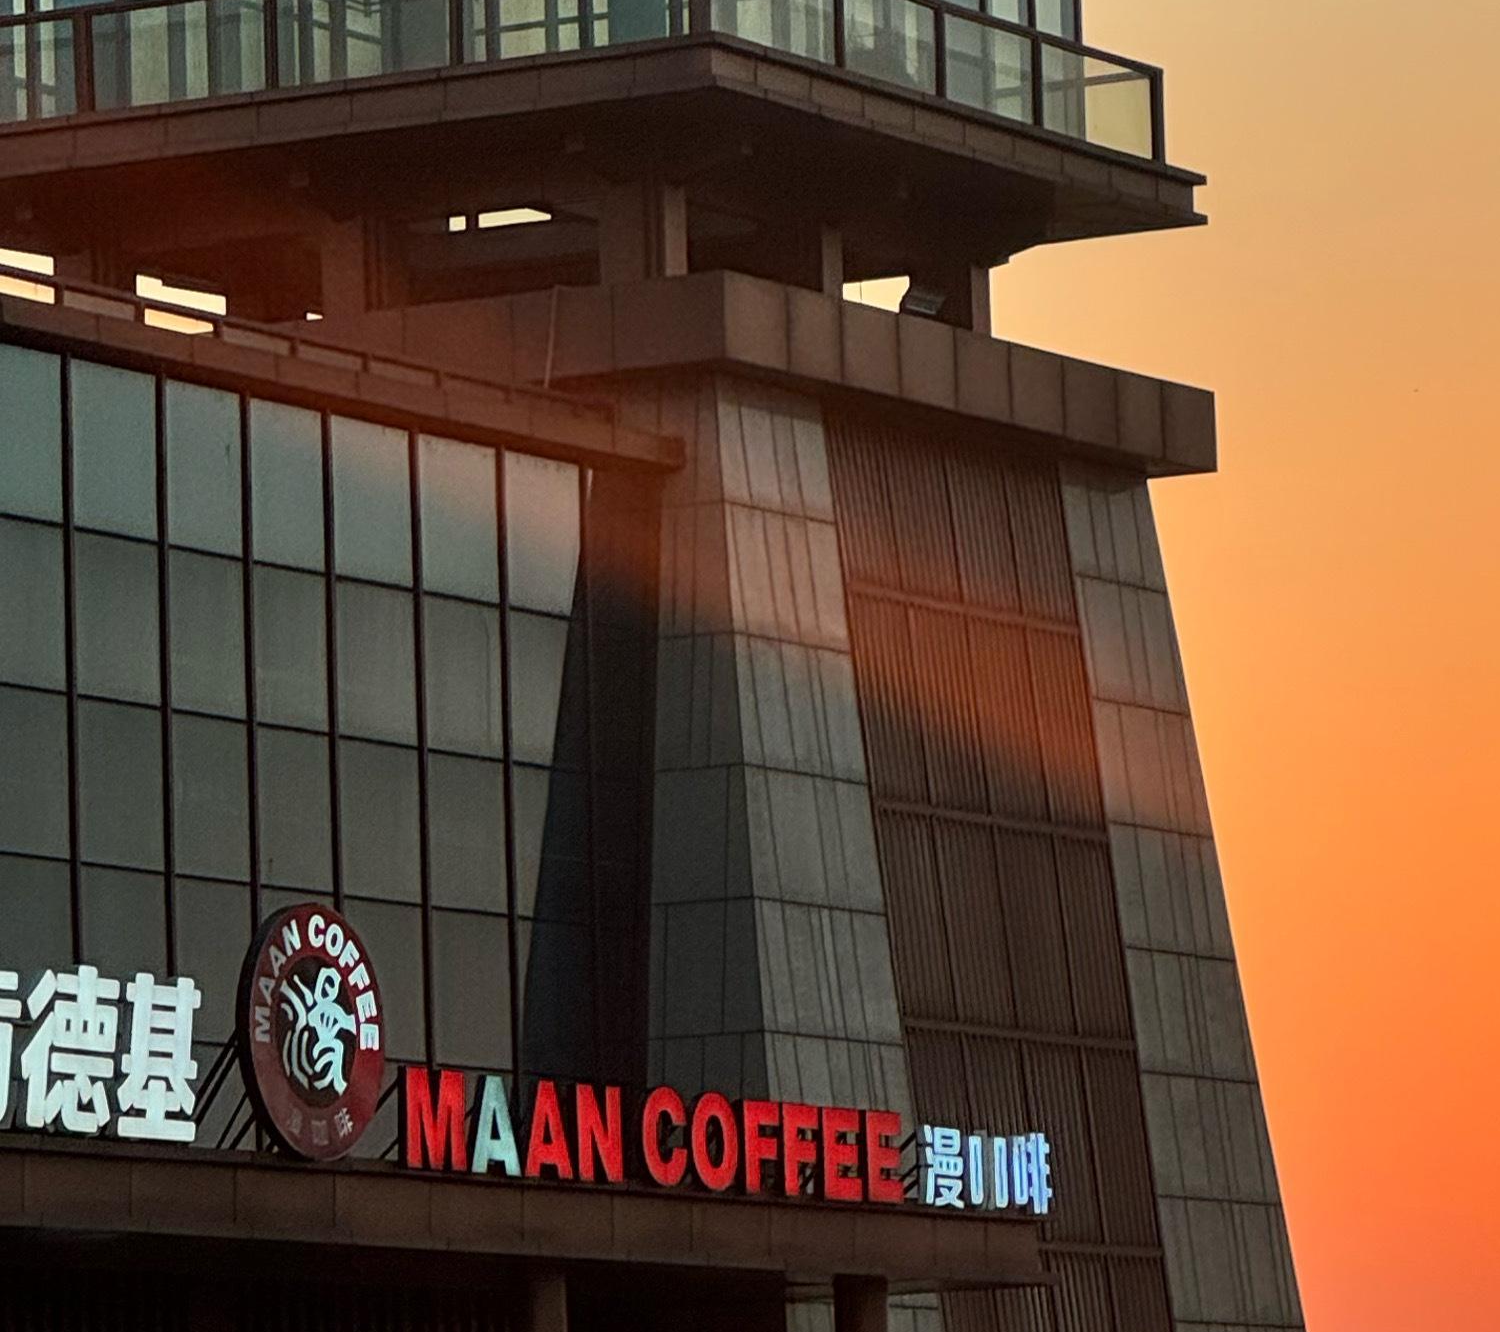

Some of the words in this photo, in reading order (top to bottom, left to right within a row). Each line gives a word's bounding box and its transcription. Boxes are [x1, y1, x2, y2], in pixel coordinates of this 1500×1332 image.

[255, 919, 301, 1043] MAAN
[308, 914, 380, 1050] COFFEE
[0, 965, 201, 1142] 德基
[405, 1067, 623, 1183] MAAN
[642, 1086, 905, 1203] COFFEE
